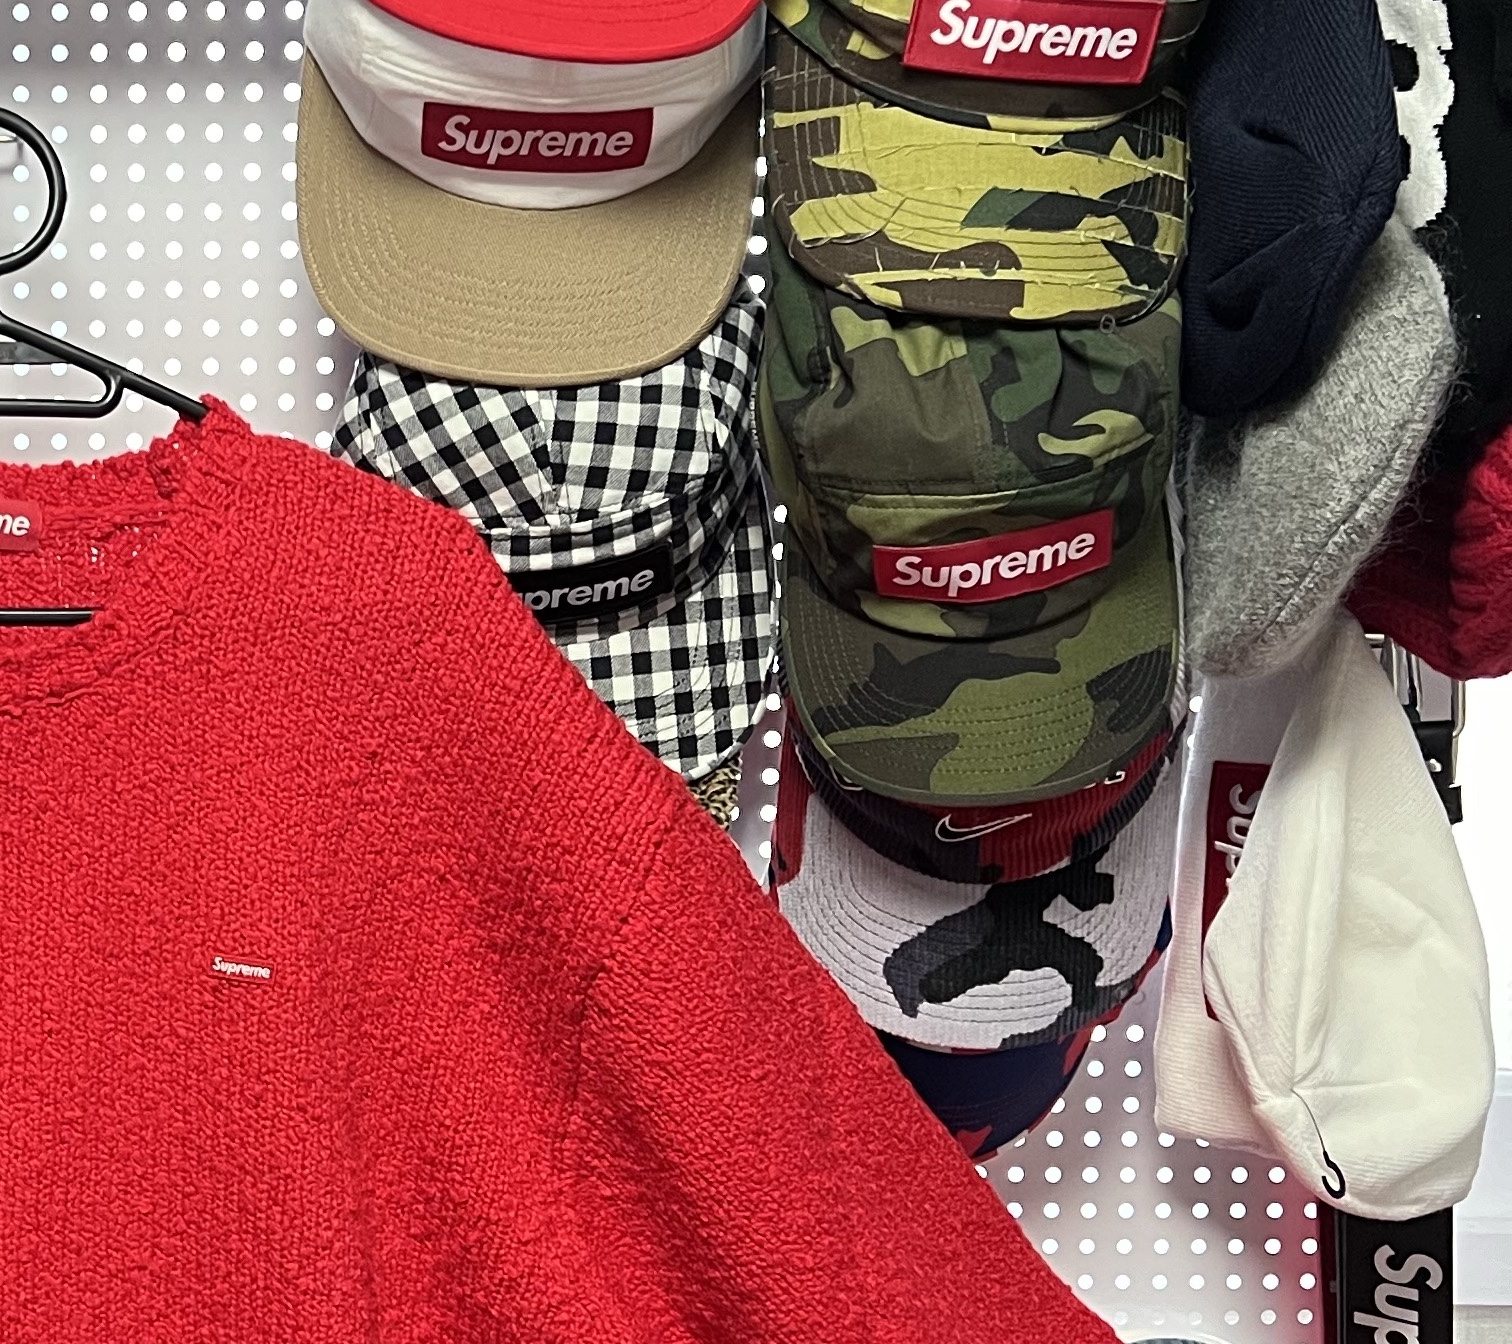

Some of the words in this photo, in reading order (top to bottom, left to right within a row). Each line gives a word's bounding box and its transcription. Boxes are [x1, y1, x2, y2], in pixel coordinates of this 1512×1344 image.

[438, 114, 634, 164] Supreme
[892, 532, 1095, 597] Supreme
[518, 569, 655, 611] preme
[212, 956, 271, 979] Supreme
